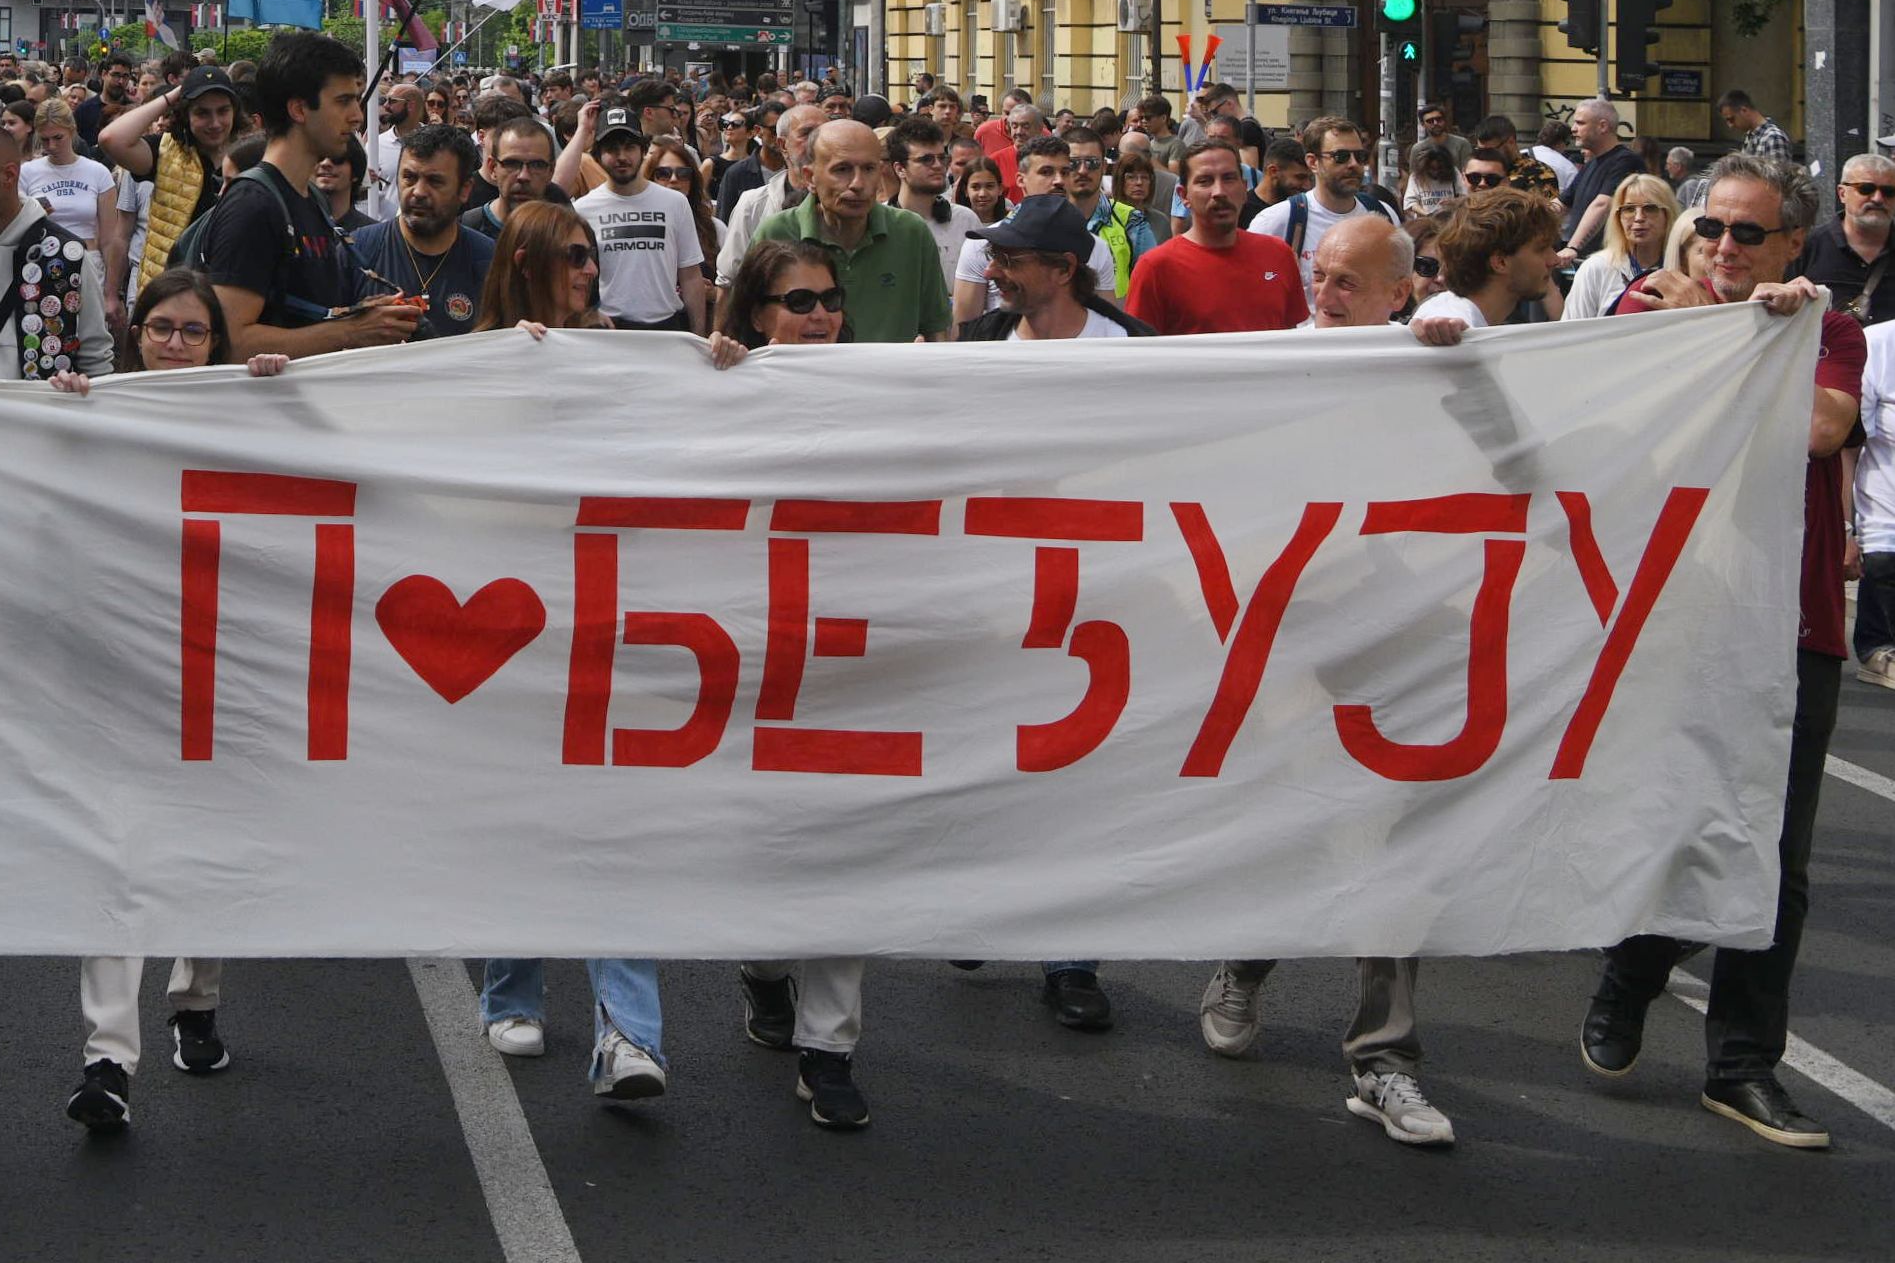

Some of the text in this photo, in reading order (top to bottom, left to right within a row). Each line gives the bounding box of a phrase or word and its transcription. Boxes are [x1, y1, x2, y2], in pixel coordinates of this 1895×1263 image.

[41, 180, 89, 193] CALIFORNIA
[56, 188, 75, 197] USA
[599, 211, 666, 225] UNDER
[604, 241, 665, 252] ARMOUR
